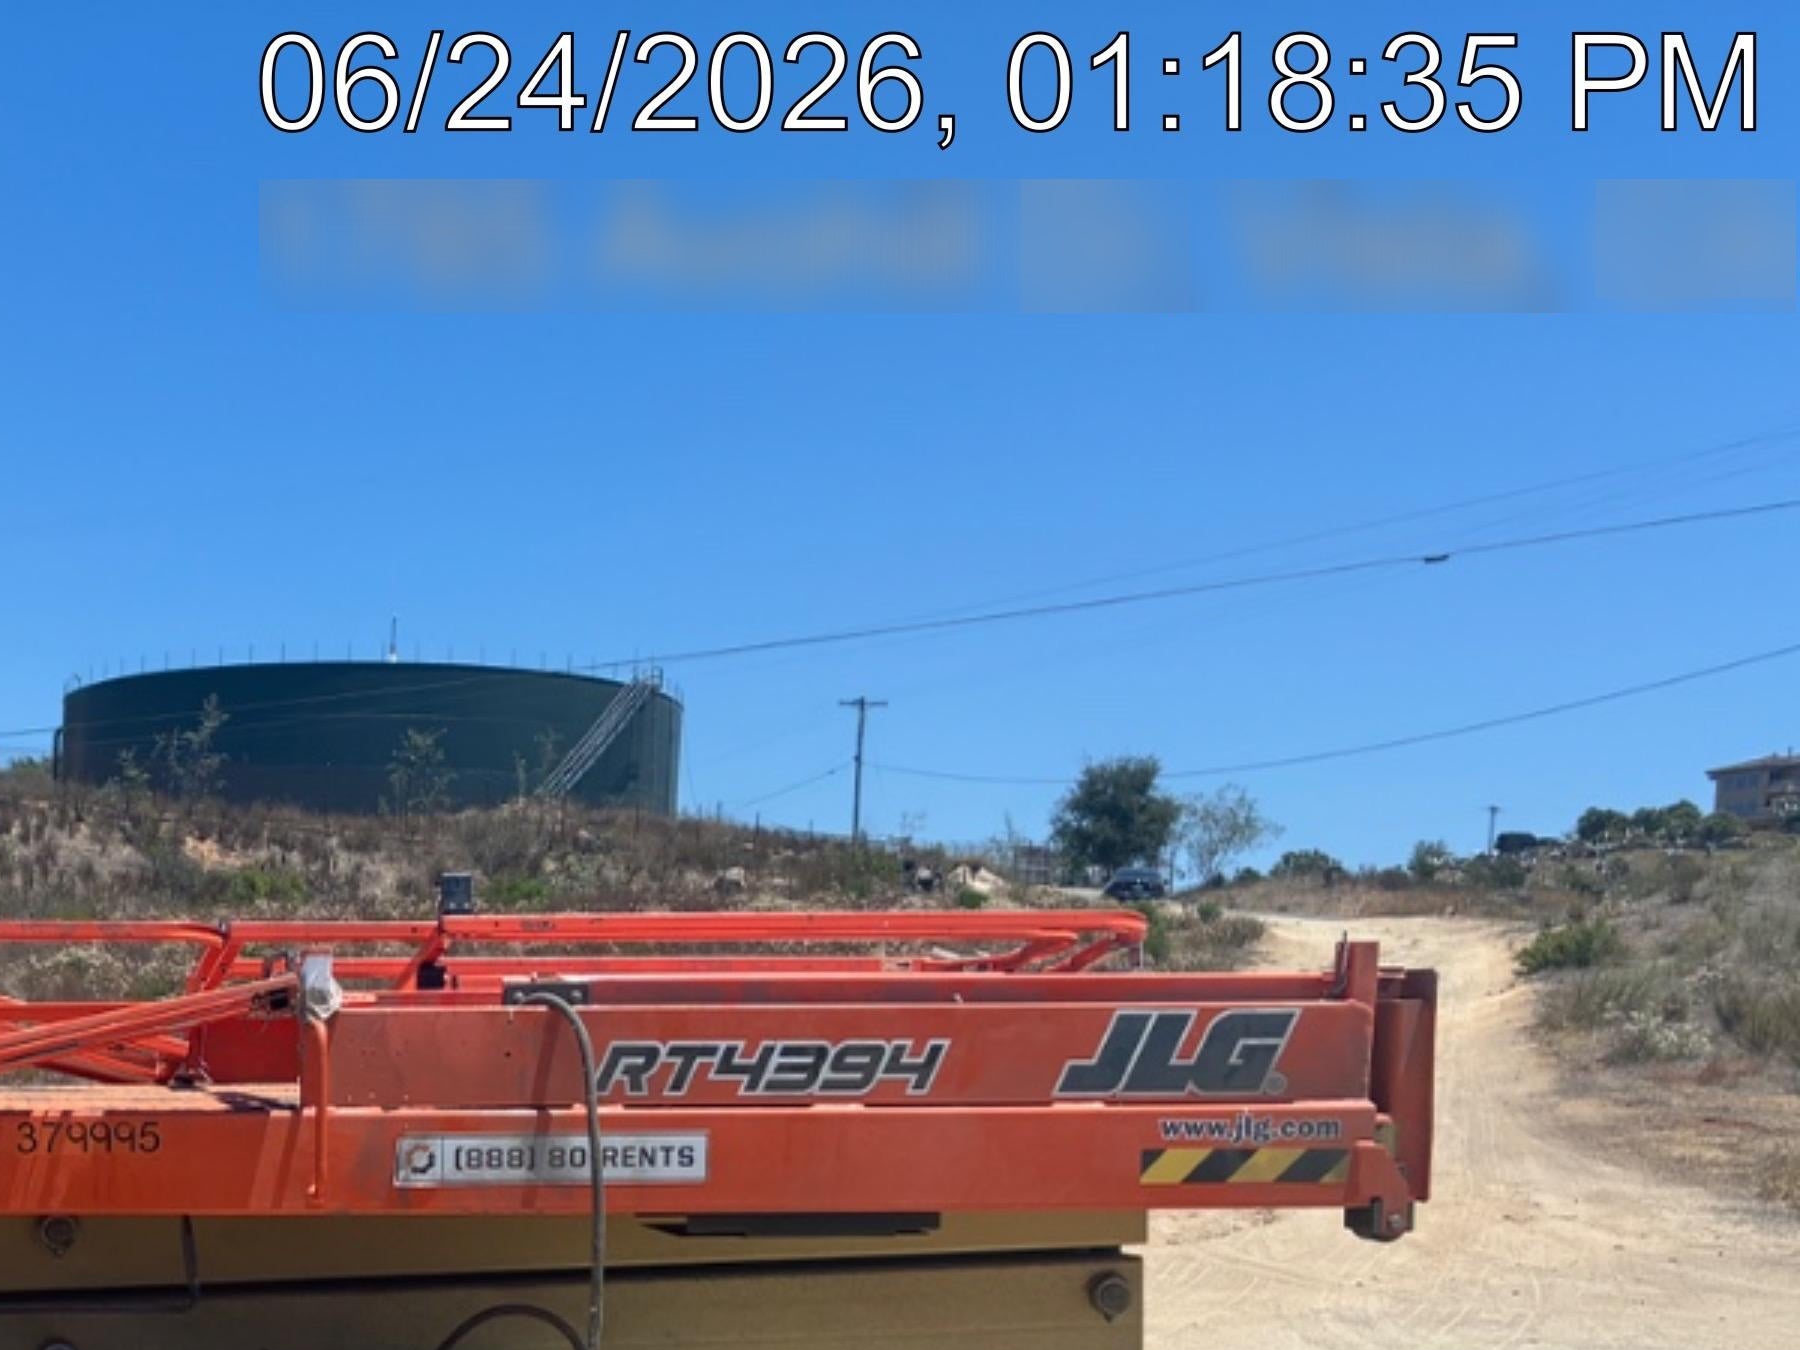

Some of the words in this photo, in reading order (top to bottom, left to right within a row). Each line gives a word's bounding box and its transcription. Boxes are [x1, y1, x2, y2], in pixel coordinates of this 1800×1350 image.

[594, 1038, 951, 1097] RT4394
[1052, 1007, 1302, 1098] JLG
[17, 1121, 161, 1153] 379995
[1159, 1113, 1341, 1143] www.jlg.com
